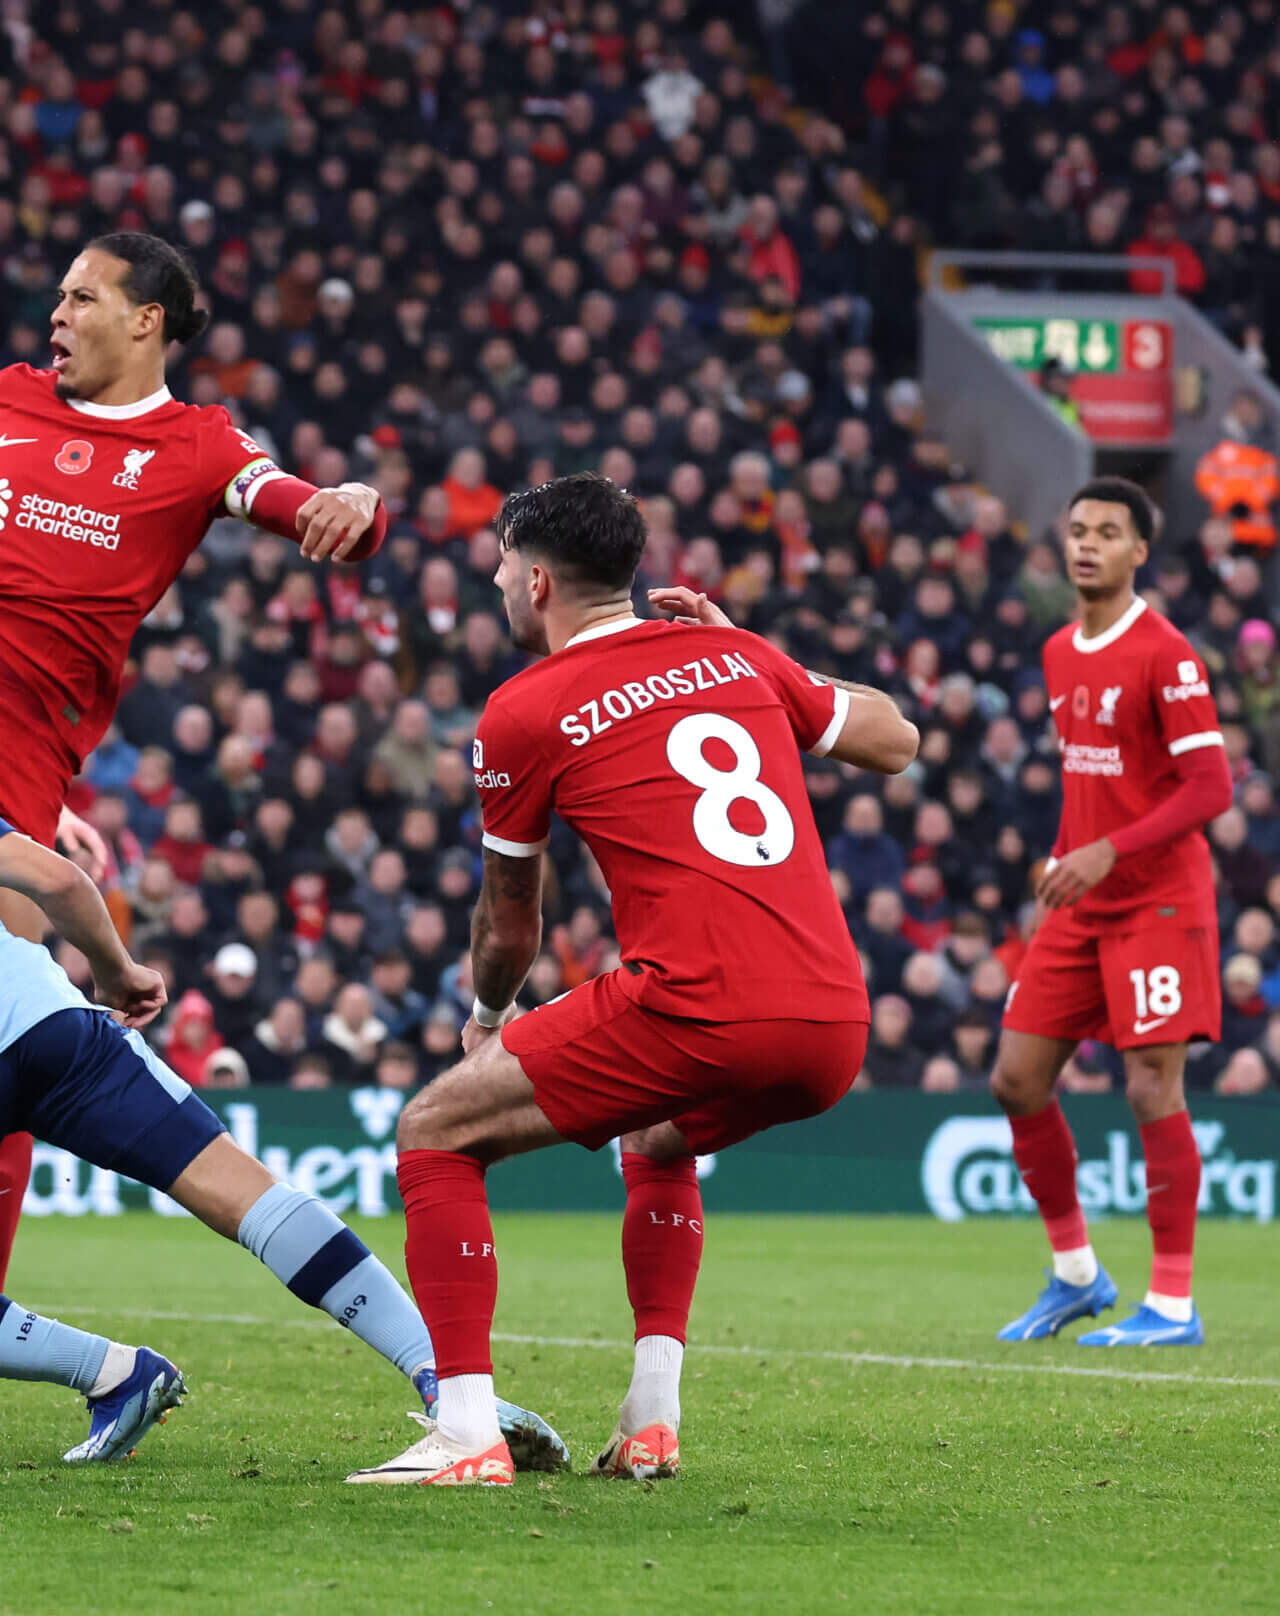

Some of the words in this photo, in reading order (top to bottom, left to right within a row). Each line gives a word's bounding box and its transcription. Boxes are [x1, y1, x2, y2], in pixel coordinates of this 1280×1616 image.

[15, 511, 121, 551] chartered
[19, 493, 121, 532] standard
[560, 652, 758, 747] SZOBOSZLAI
[666, 712, 795, 867] 8
[1129, 965, 1182, 1018] 18
[460, 1241, 497, 1257] LF
